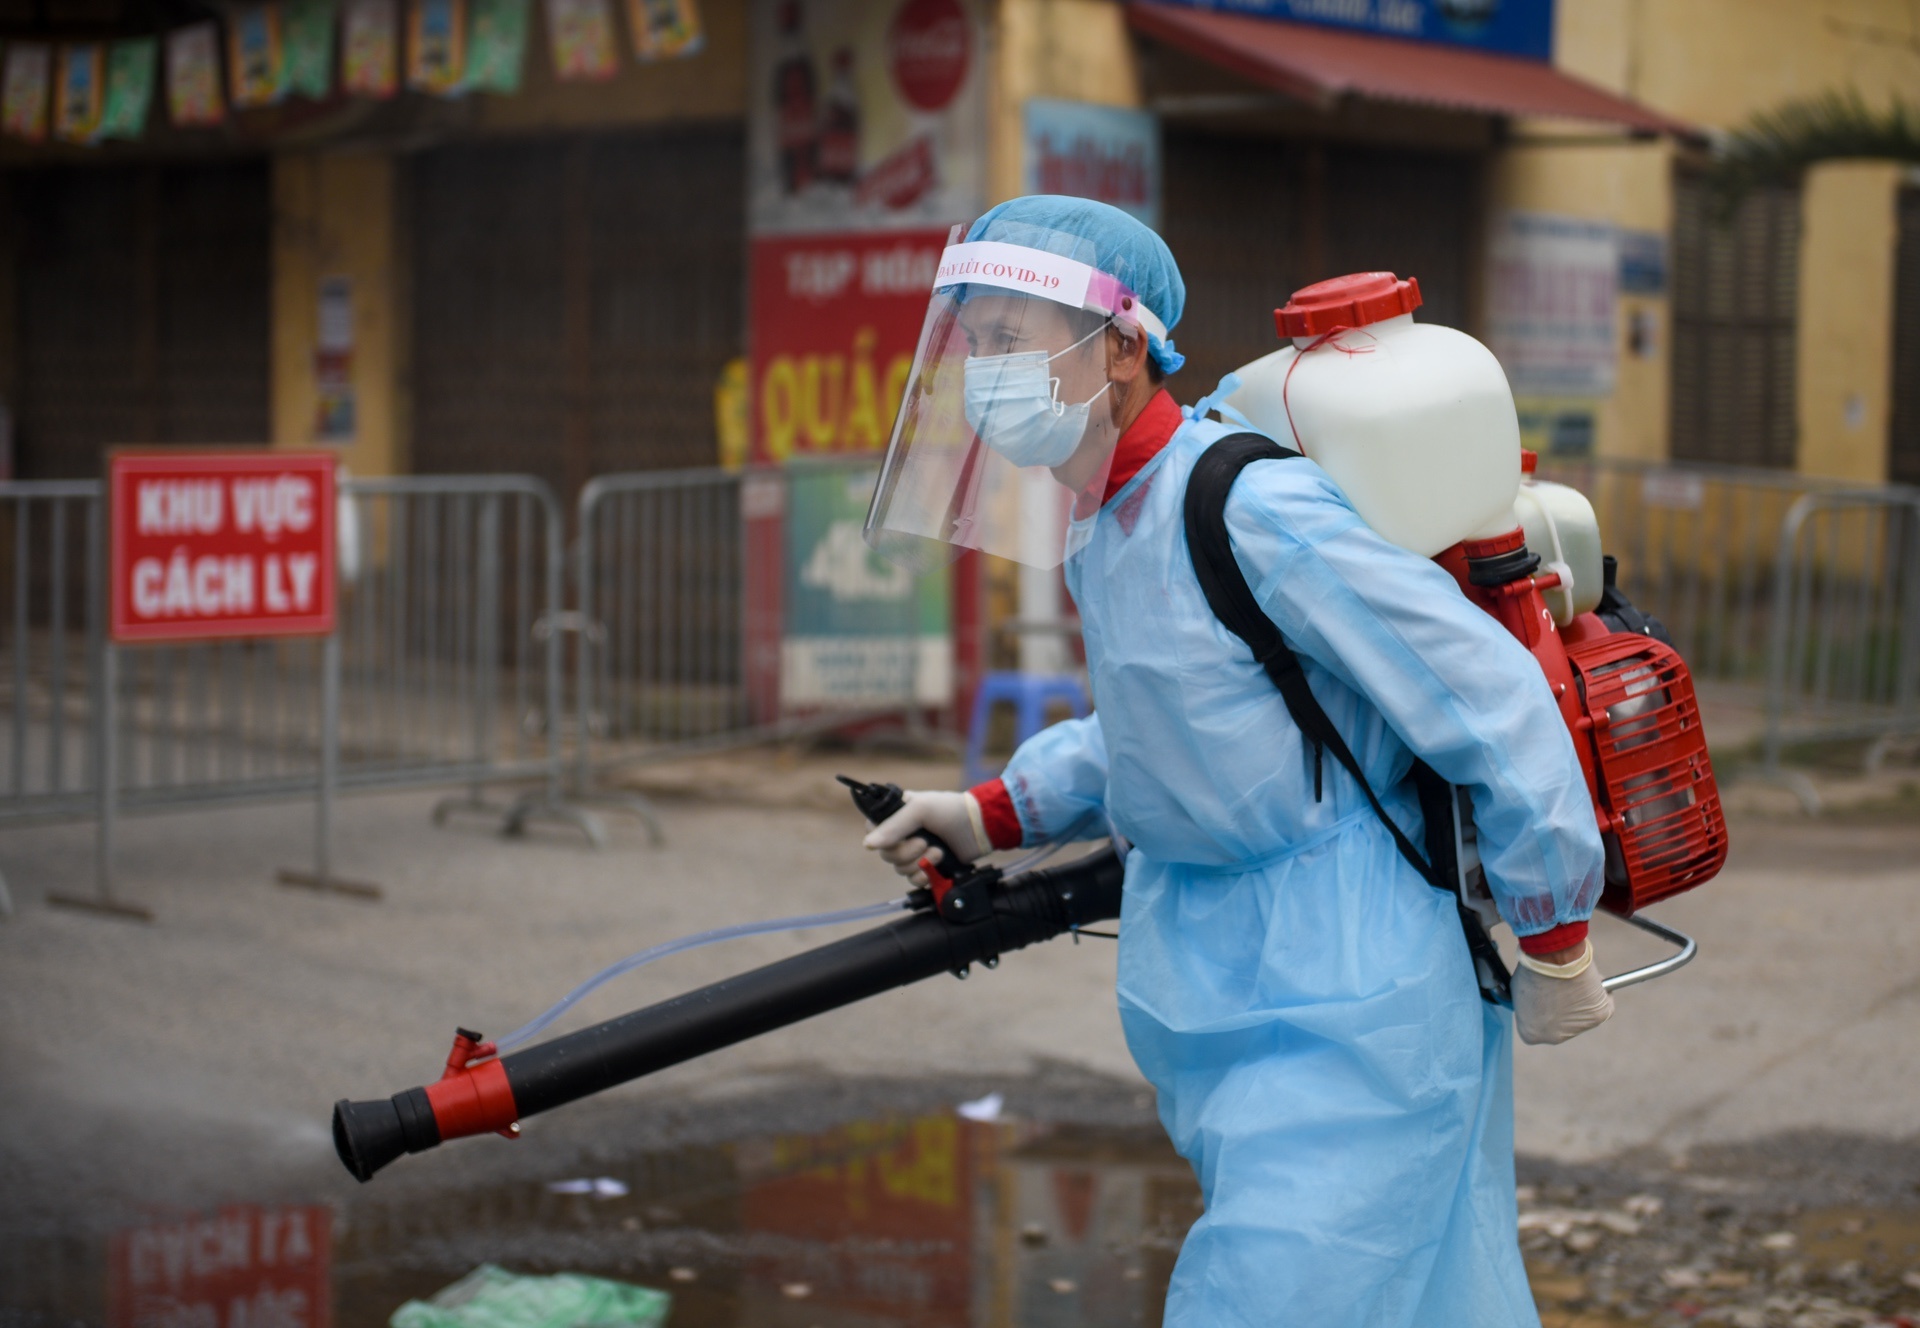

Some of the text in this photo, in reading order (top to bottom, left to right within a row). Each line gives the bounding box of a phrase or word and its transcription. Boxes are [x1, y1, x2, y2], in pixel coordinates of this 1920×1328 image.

[982, 261, 1060, 289] COVID-19
[137, 472, 316, 543] KHU VỰC
[131, 546, 317, 618] CÁCH LY
